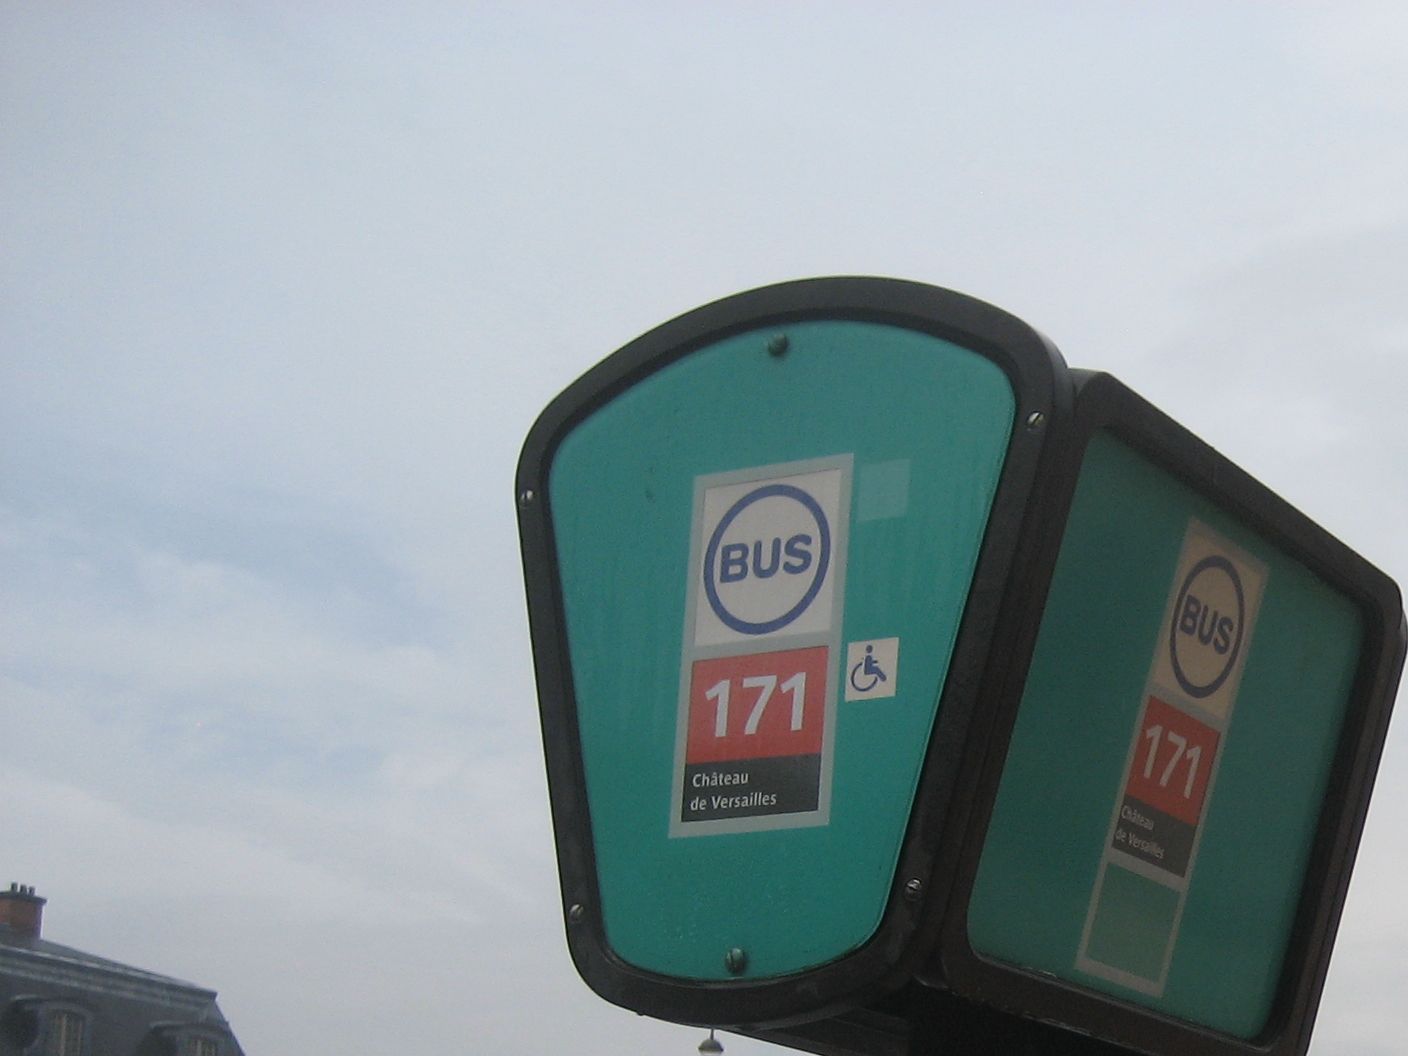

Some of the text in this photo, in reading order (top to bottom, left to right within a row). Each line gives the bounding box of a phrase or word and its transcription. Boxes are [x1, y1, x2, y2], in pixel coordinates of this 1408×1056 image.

[718, 533, 814, 584] BUS
[1179, 594, 1235, 655] BUS
[704, 671, 808, 739] 171
[691, 771, 749, 788] Château
[1144, 723, 1202, 800] 171
[690, 791, 778, 811] de Versailles
